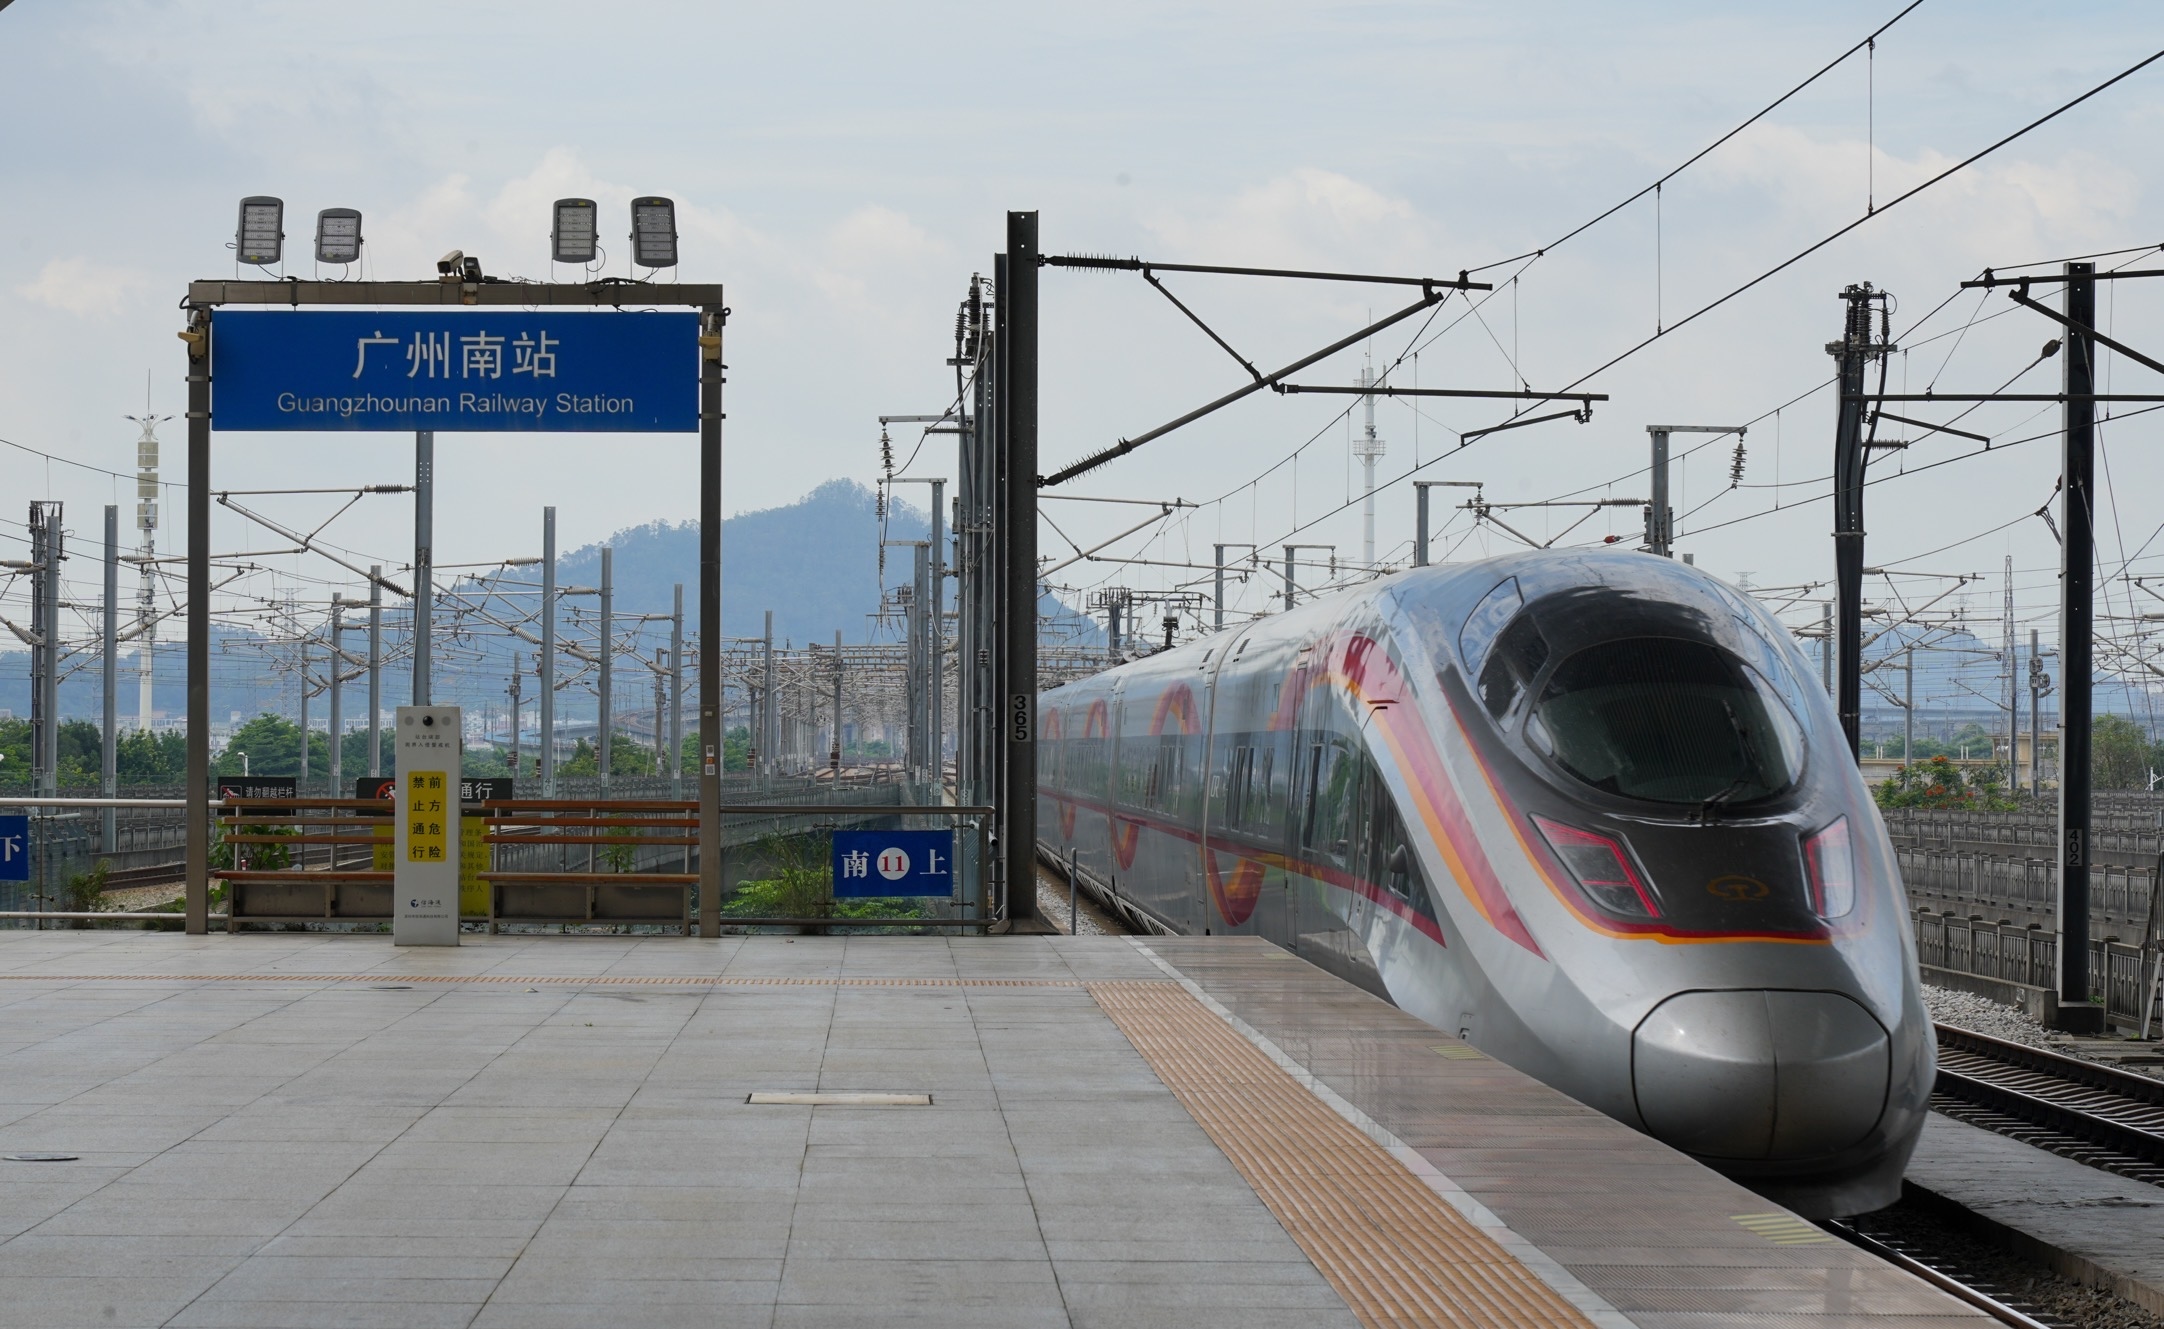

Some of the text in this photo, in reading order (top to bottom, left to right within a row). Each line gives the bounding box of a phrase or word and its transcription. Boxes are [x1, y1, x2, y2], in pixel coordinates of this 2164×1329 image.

[352, 330, 560, 379] 广州南站
[277, 392, 634, 417] Guangzhounan Railway Station
[1013, 695, 1028, 741] 365
[245, 786, 293, 798] 请勿翻越栏杆
[412, 776, 425, 858] 禁止通行
[428, 776, 441, 858] 前方危险
[0, 834, 22, 862] 下
[841, 849, 948, 878] 南 11 上
[2069, 830, 2079, 865] 402
